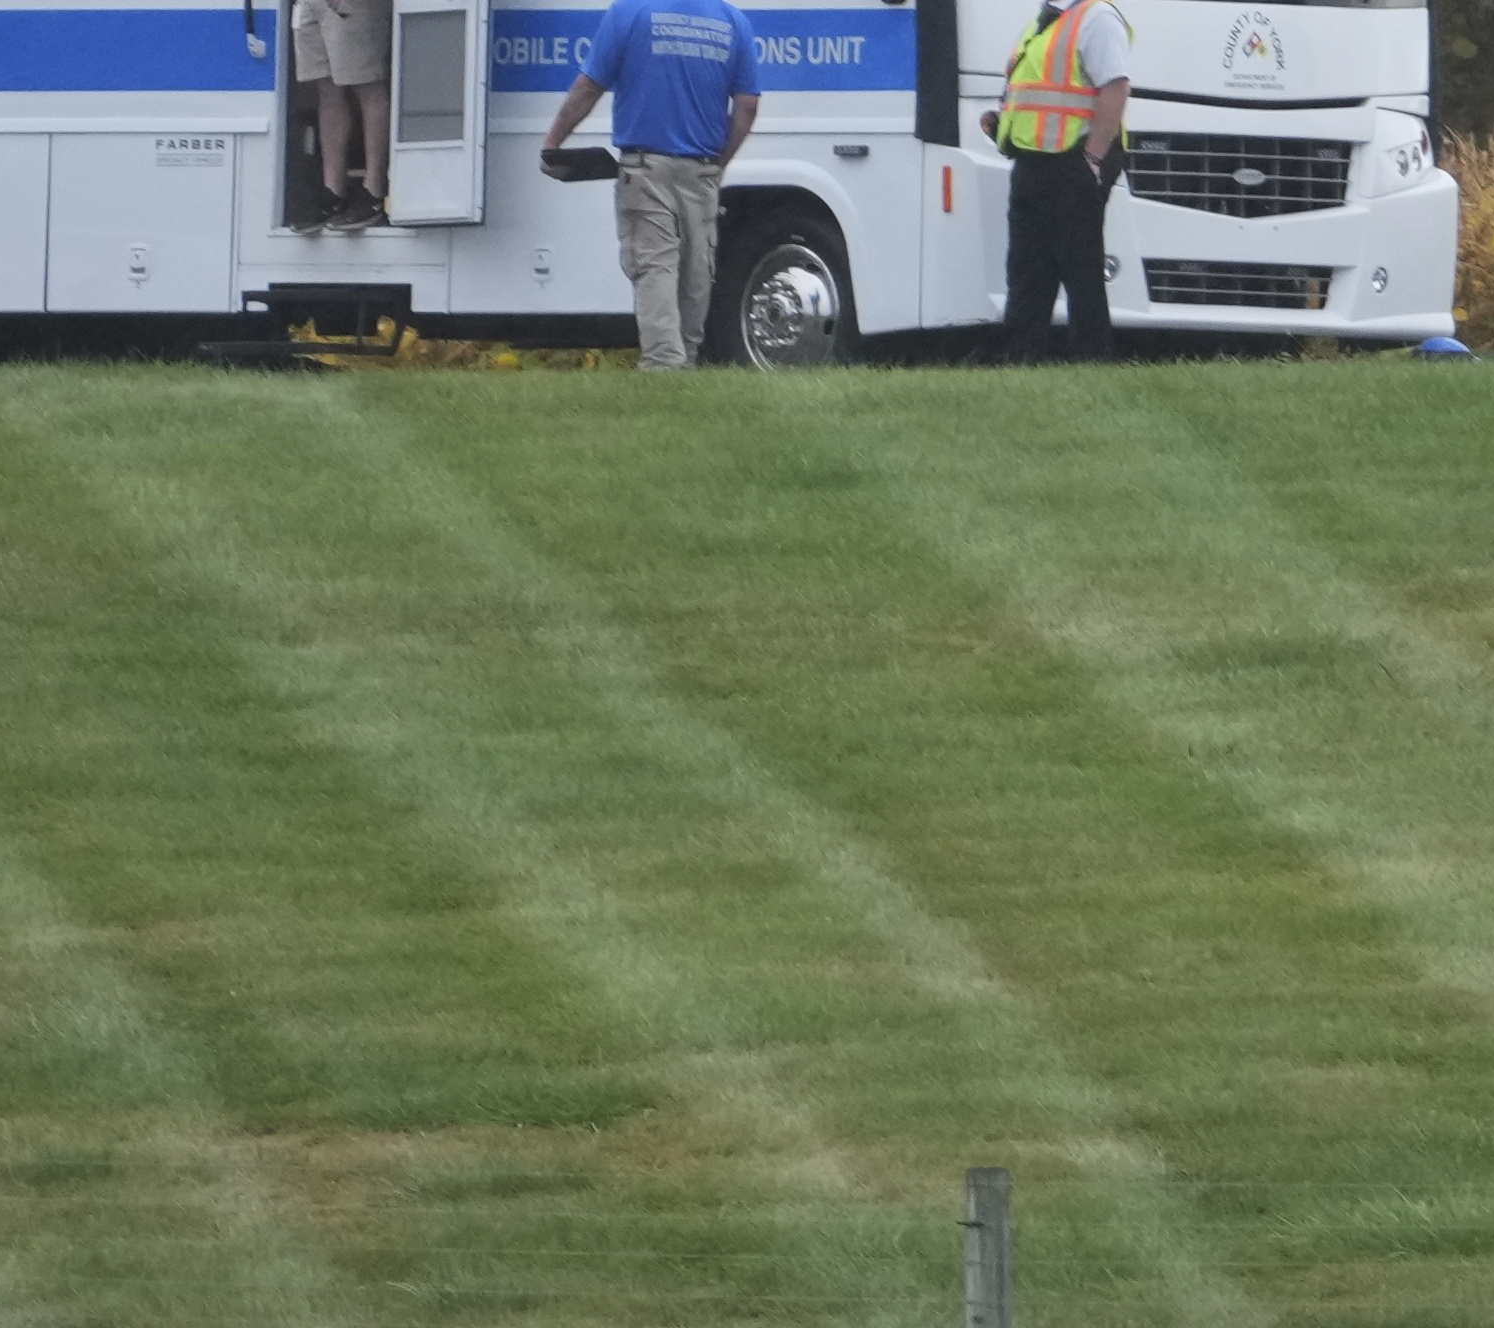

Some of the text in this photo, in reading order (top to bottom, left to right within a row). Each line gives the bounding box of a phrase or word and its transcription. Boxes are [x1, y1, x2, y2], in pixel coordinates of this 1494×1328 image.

[493, 36, 569, 65] OBILE
[807, 36, 865, 64] UNIT
[1223, 11, 1286, 70] COUNTY OF YORK
[155, 139, 225, 150] FARBER
